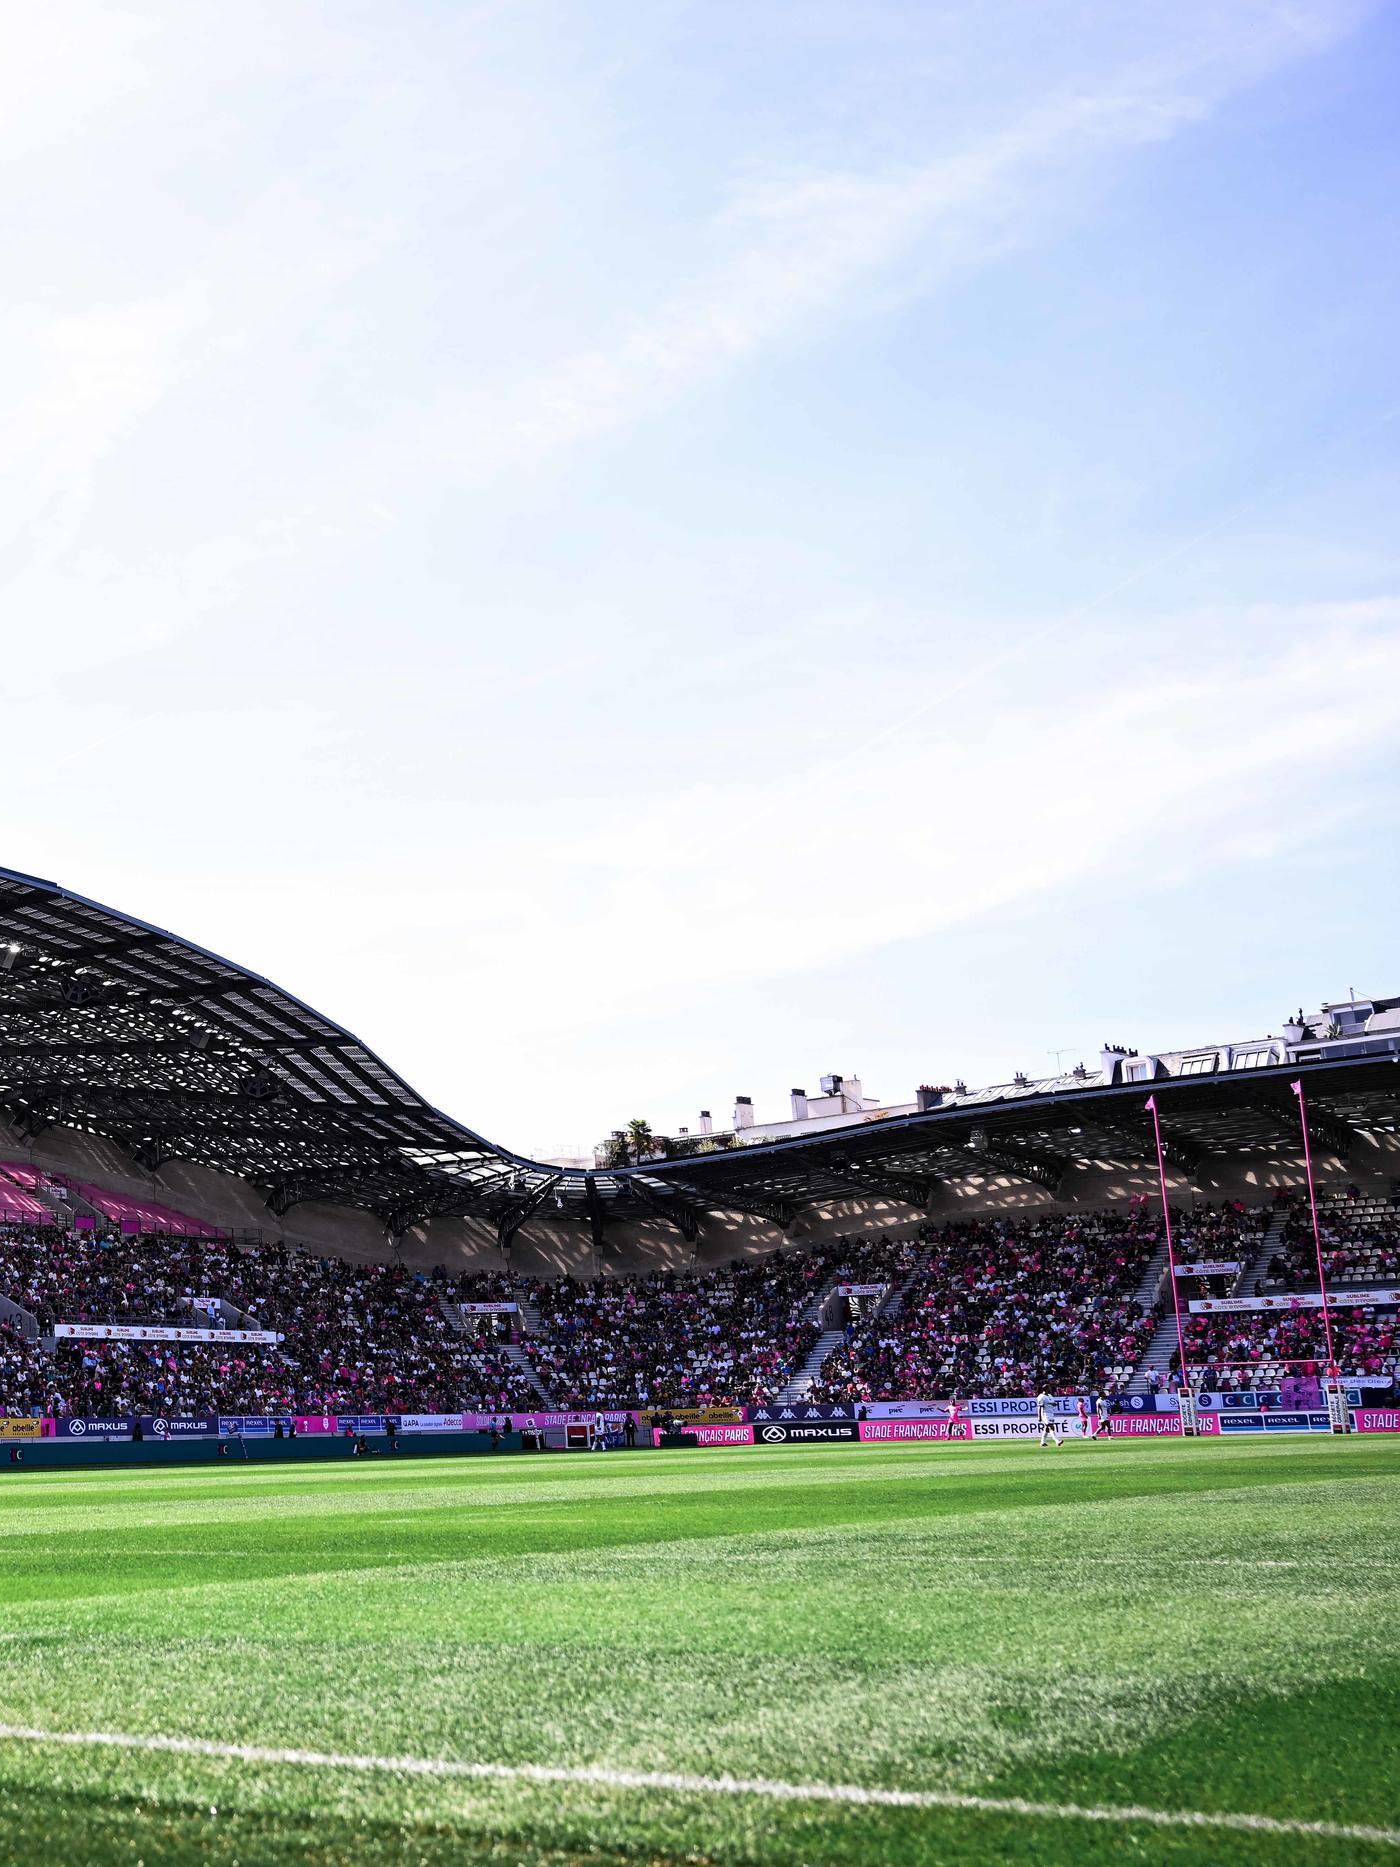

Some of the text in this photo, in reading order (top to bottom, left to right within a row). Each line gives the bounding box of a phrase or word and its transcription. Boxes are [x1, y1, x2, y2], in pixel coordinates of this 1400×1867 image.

[971, 1400, 998, 1413] ESSI
[544, 1415, 567, 1425] STADE
[604, 1413, 627, 1423] PARIS
[708, 1411, 734, 1419] abeille
[170, 1421, 208, 1430] MAXUS
[403, 1419, 419, 1427] QAPA
[443, 1418, 462, 1426] Adecco
[1363, 1413, 1399, 1428] STADE
[12, 1424, 35, 1432] abeille
[88, 1422, 128, 1431] MAXUS
[974, 1420, 1069, 1435] ESSI PROPRTÉ
[1131, 1416, 1180, 1436] FRANÇAIS
[724, 1428, 749, 1441] PARIS
[790, 1428, 852, 1437] MAXUS
[864, 1424, 892, 1439] STADE
[894, 1423, 938, 1441] FRANÇAIS
